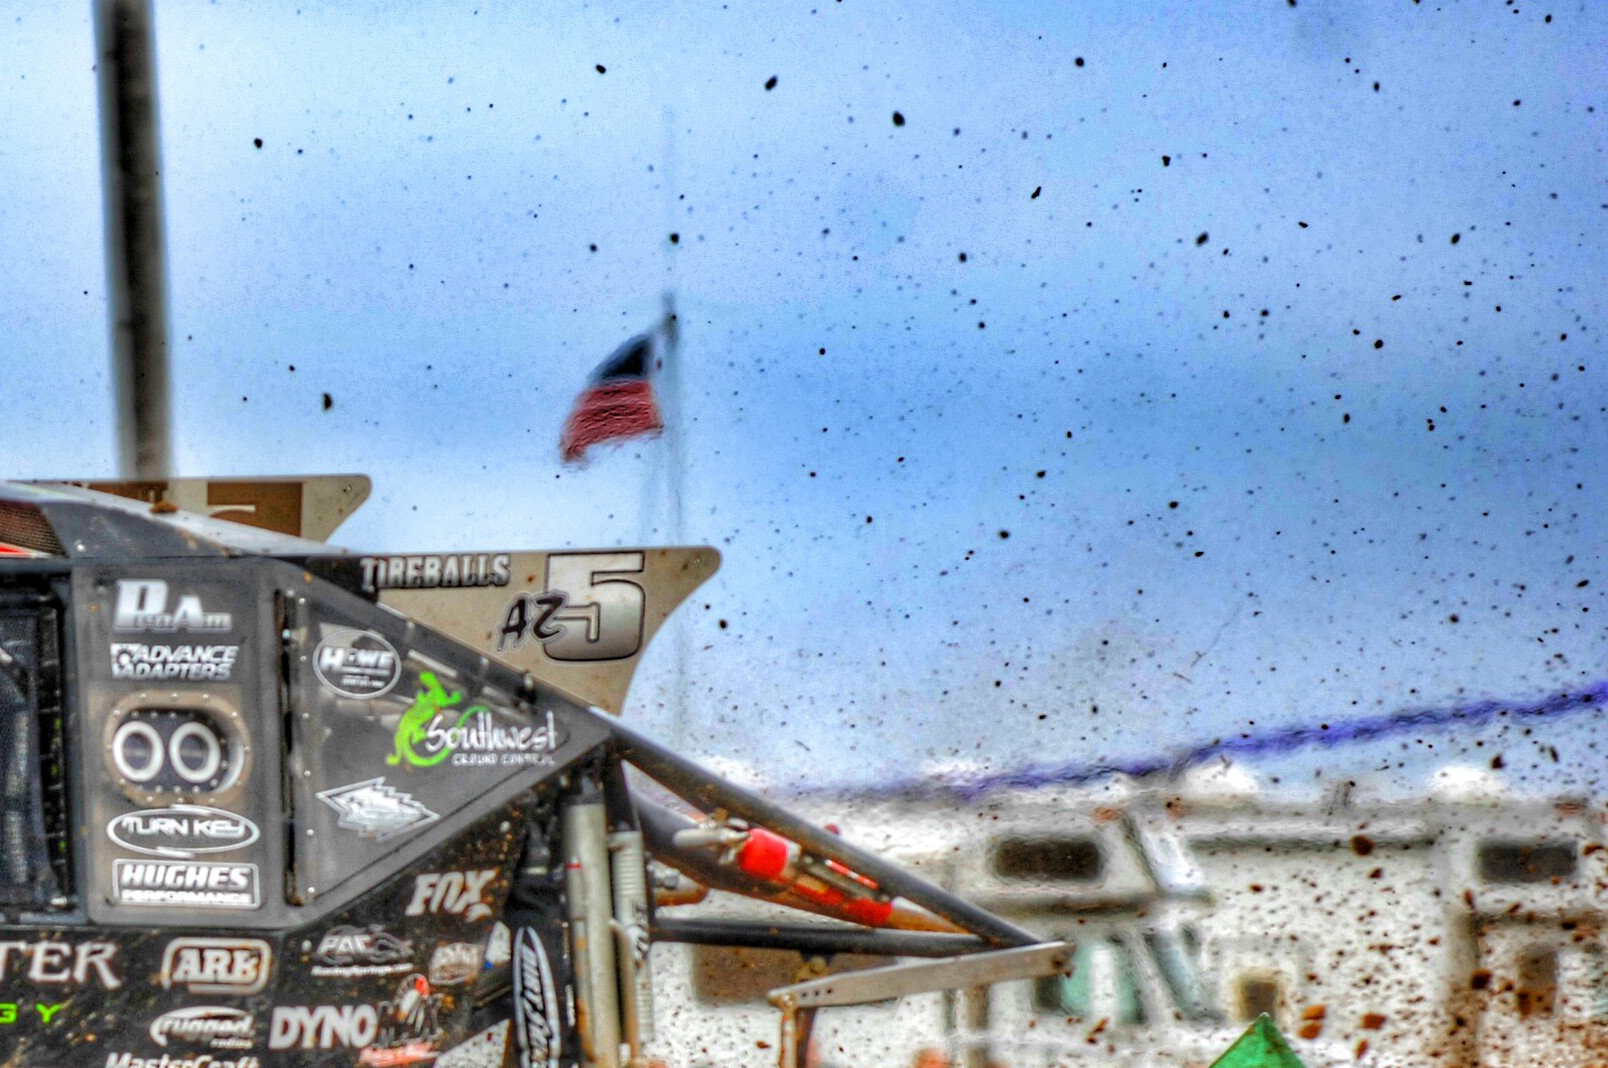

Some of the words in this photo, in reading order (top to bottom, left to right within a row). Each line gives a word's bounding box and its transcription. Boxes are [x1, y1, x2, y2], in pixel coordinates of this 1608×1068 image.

[543, 550, 645, 662] 5
[131, 644, 239, 664] ADVANCE
[118, 662, 232, 680] ADAPTERS
[425, 710, 557, 752] Southwest
[121, 816, 189, 836] TURN
[193, 819, 246, 838] KEY
[120, 864, 251, 889] HUGHES
[404, 869, 496, 922] FOX
[268, 1004, 378, 1051] DYNO
